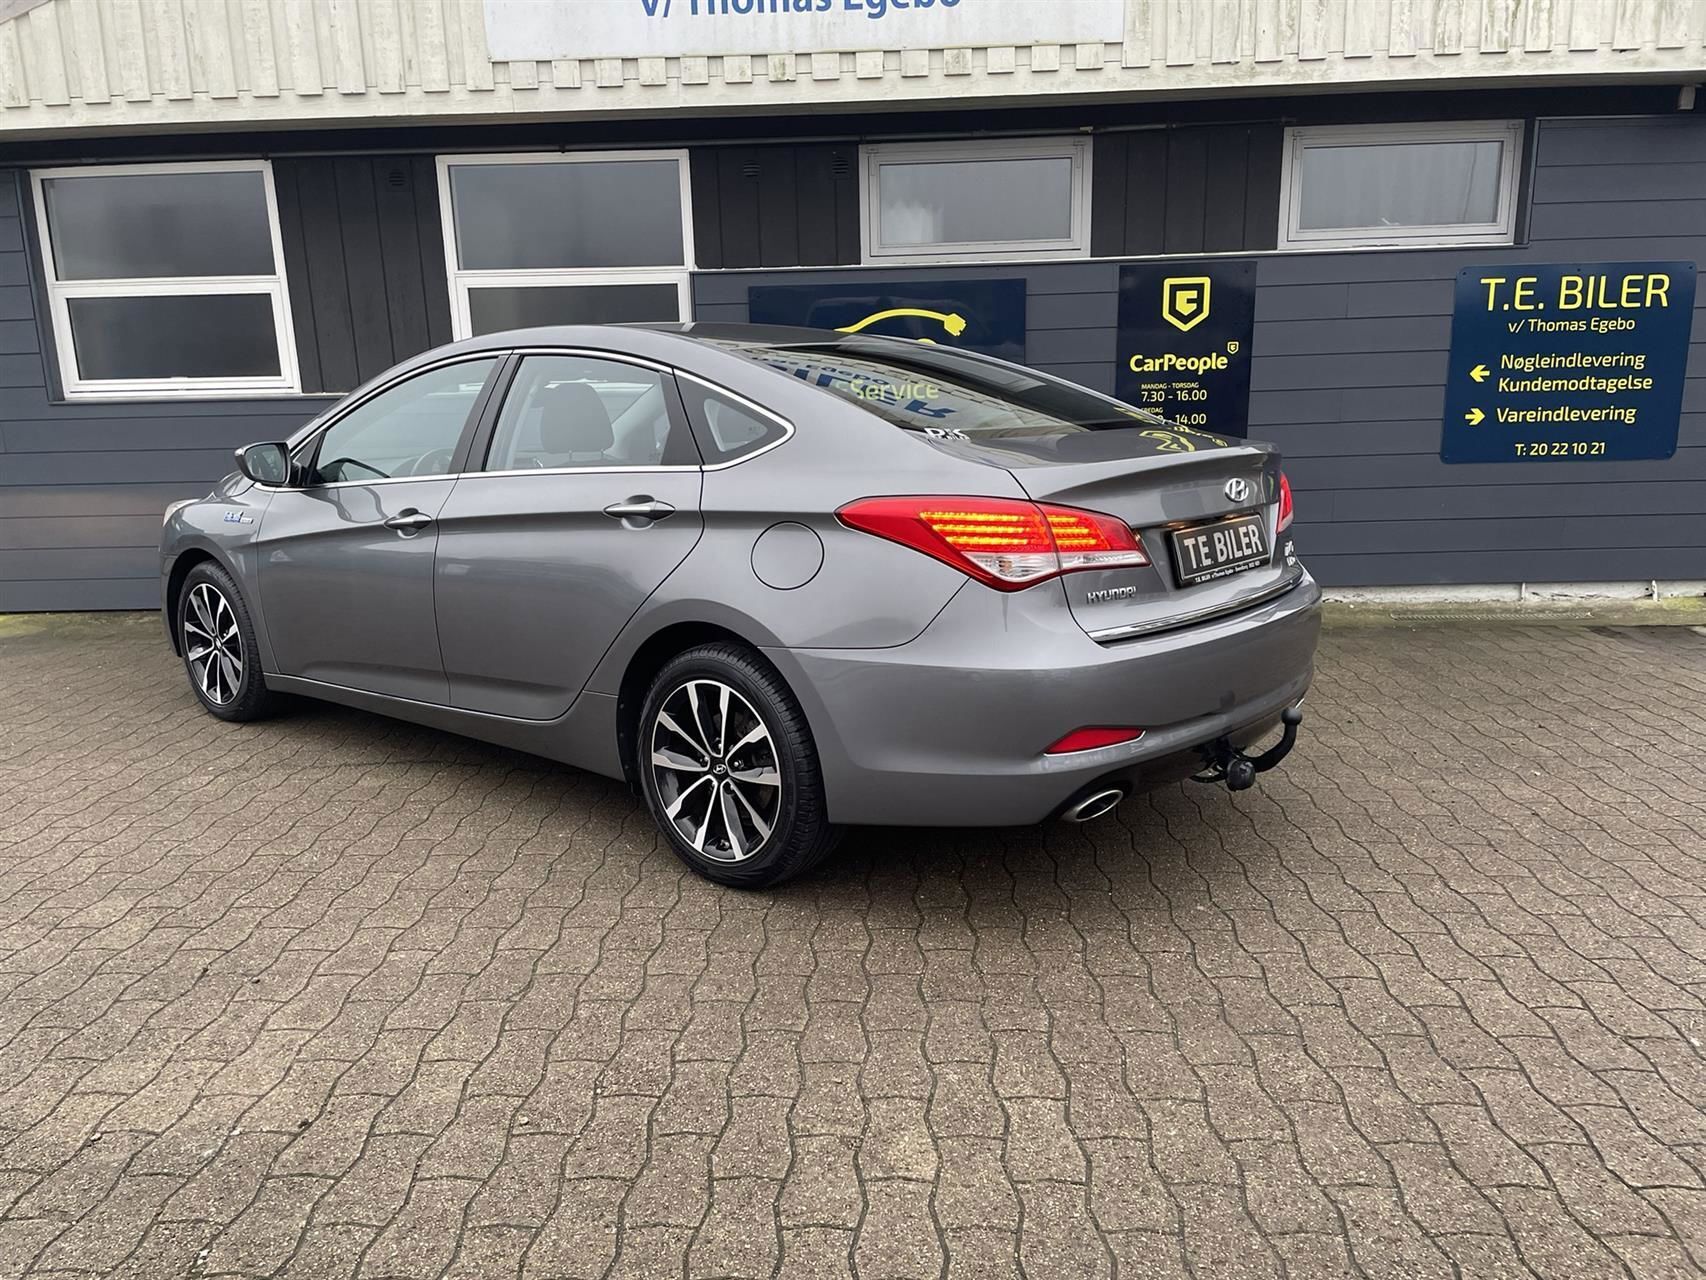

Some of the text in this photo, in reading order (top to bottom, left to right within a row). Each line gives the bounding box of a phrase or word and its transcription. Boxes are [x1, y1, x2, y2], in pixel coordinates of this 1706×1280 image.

[1480, 274, 1670, 311] T.E. BILER
[1508, 317, 1636, 333] v/ Thomas Egebo
[1129, 352, 1229, 375] CarPeople
[1501, 352, 1646, 373] Nøgleindlevering
[850, 378, 939, 401] Service
[1172, 381, 1200, 389] TORSDAG
[1498, 374, 1653, 393] Kundemodtagelse
[1141, 391, 1165, 402] 7.30
[1176, 389, 1208, 401] 16.00
[1174, 413, 1207, 425] 14.00
[1496, 405, 1637, 424] Vareindlevering
[1514, 442, 1606, 456] T: 20 22 10 21
[1183, 535, 1215, 569] T.E.
[1213, 524, 1263, 562] BILER
